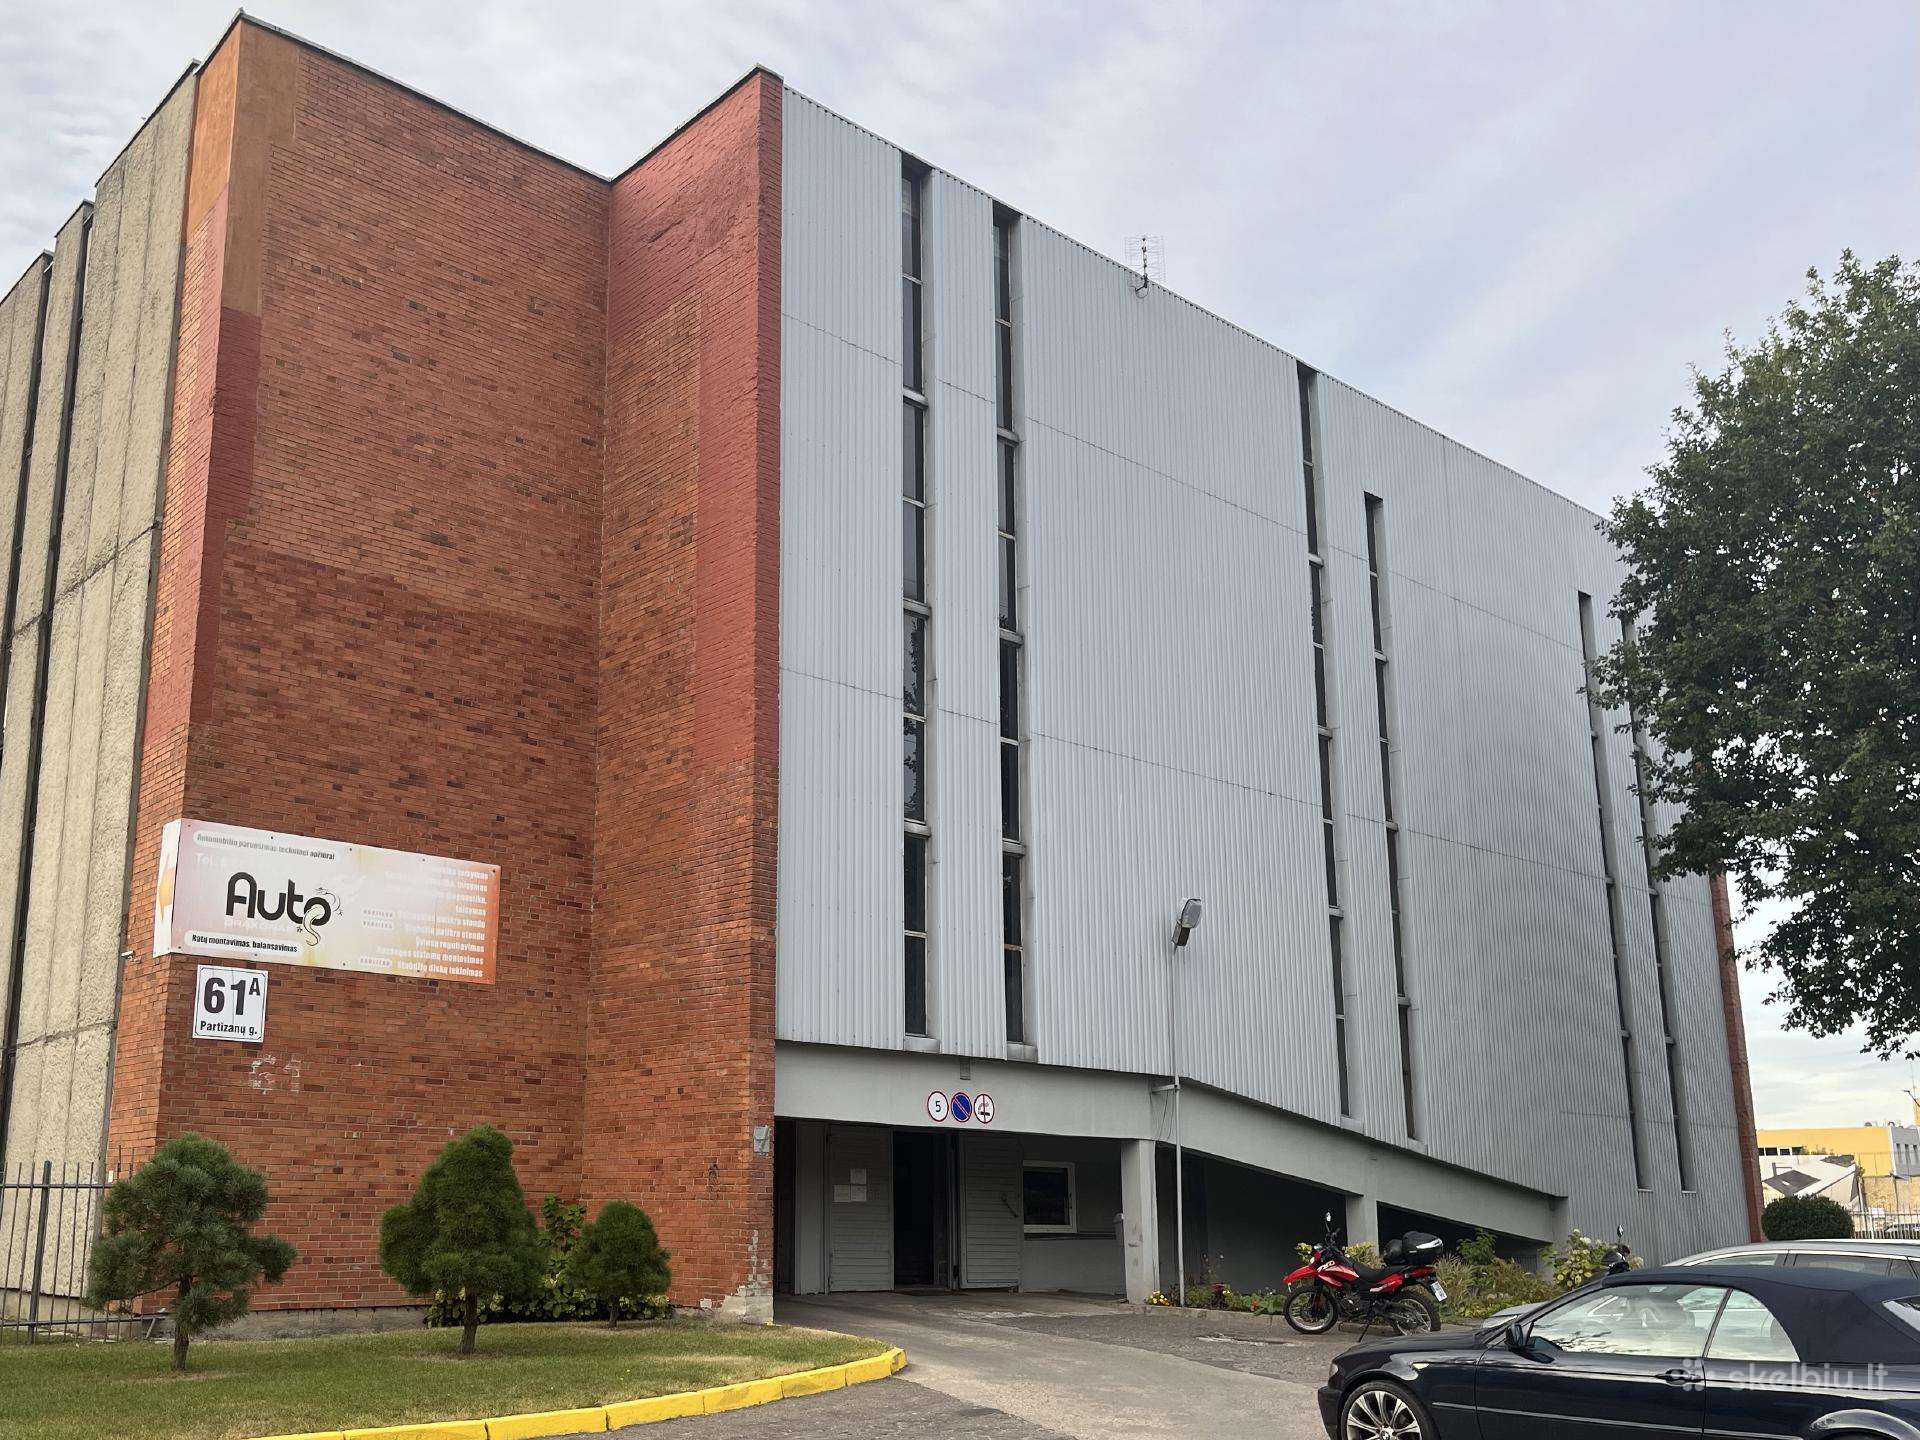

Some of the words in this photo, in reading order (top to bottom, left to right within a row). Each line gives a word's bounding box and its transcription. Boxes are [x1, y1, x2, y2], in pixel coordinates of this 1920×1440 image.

[225, 872, 332, 926] Auto
[252, 941, 298, 952] balansavimas
[200, 1020, 246, 1036] Partizanų
[249, 1026, 258, 1036] g.
[935, 1100, 942, 1113] 5
